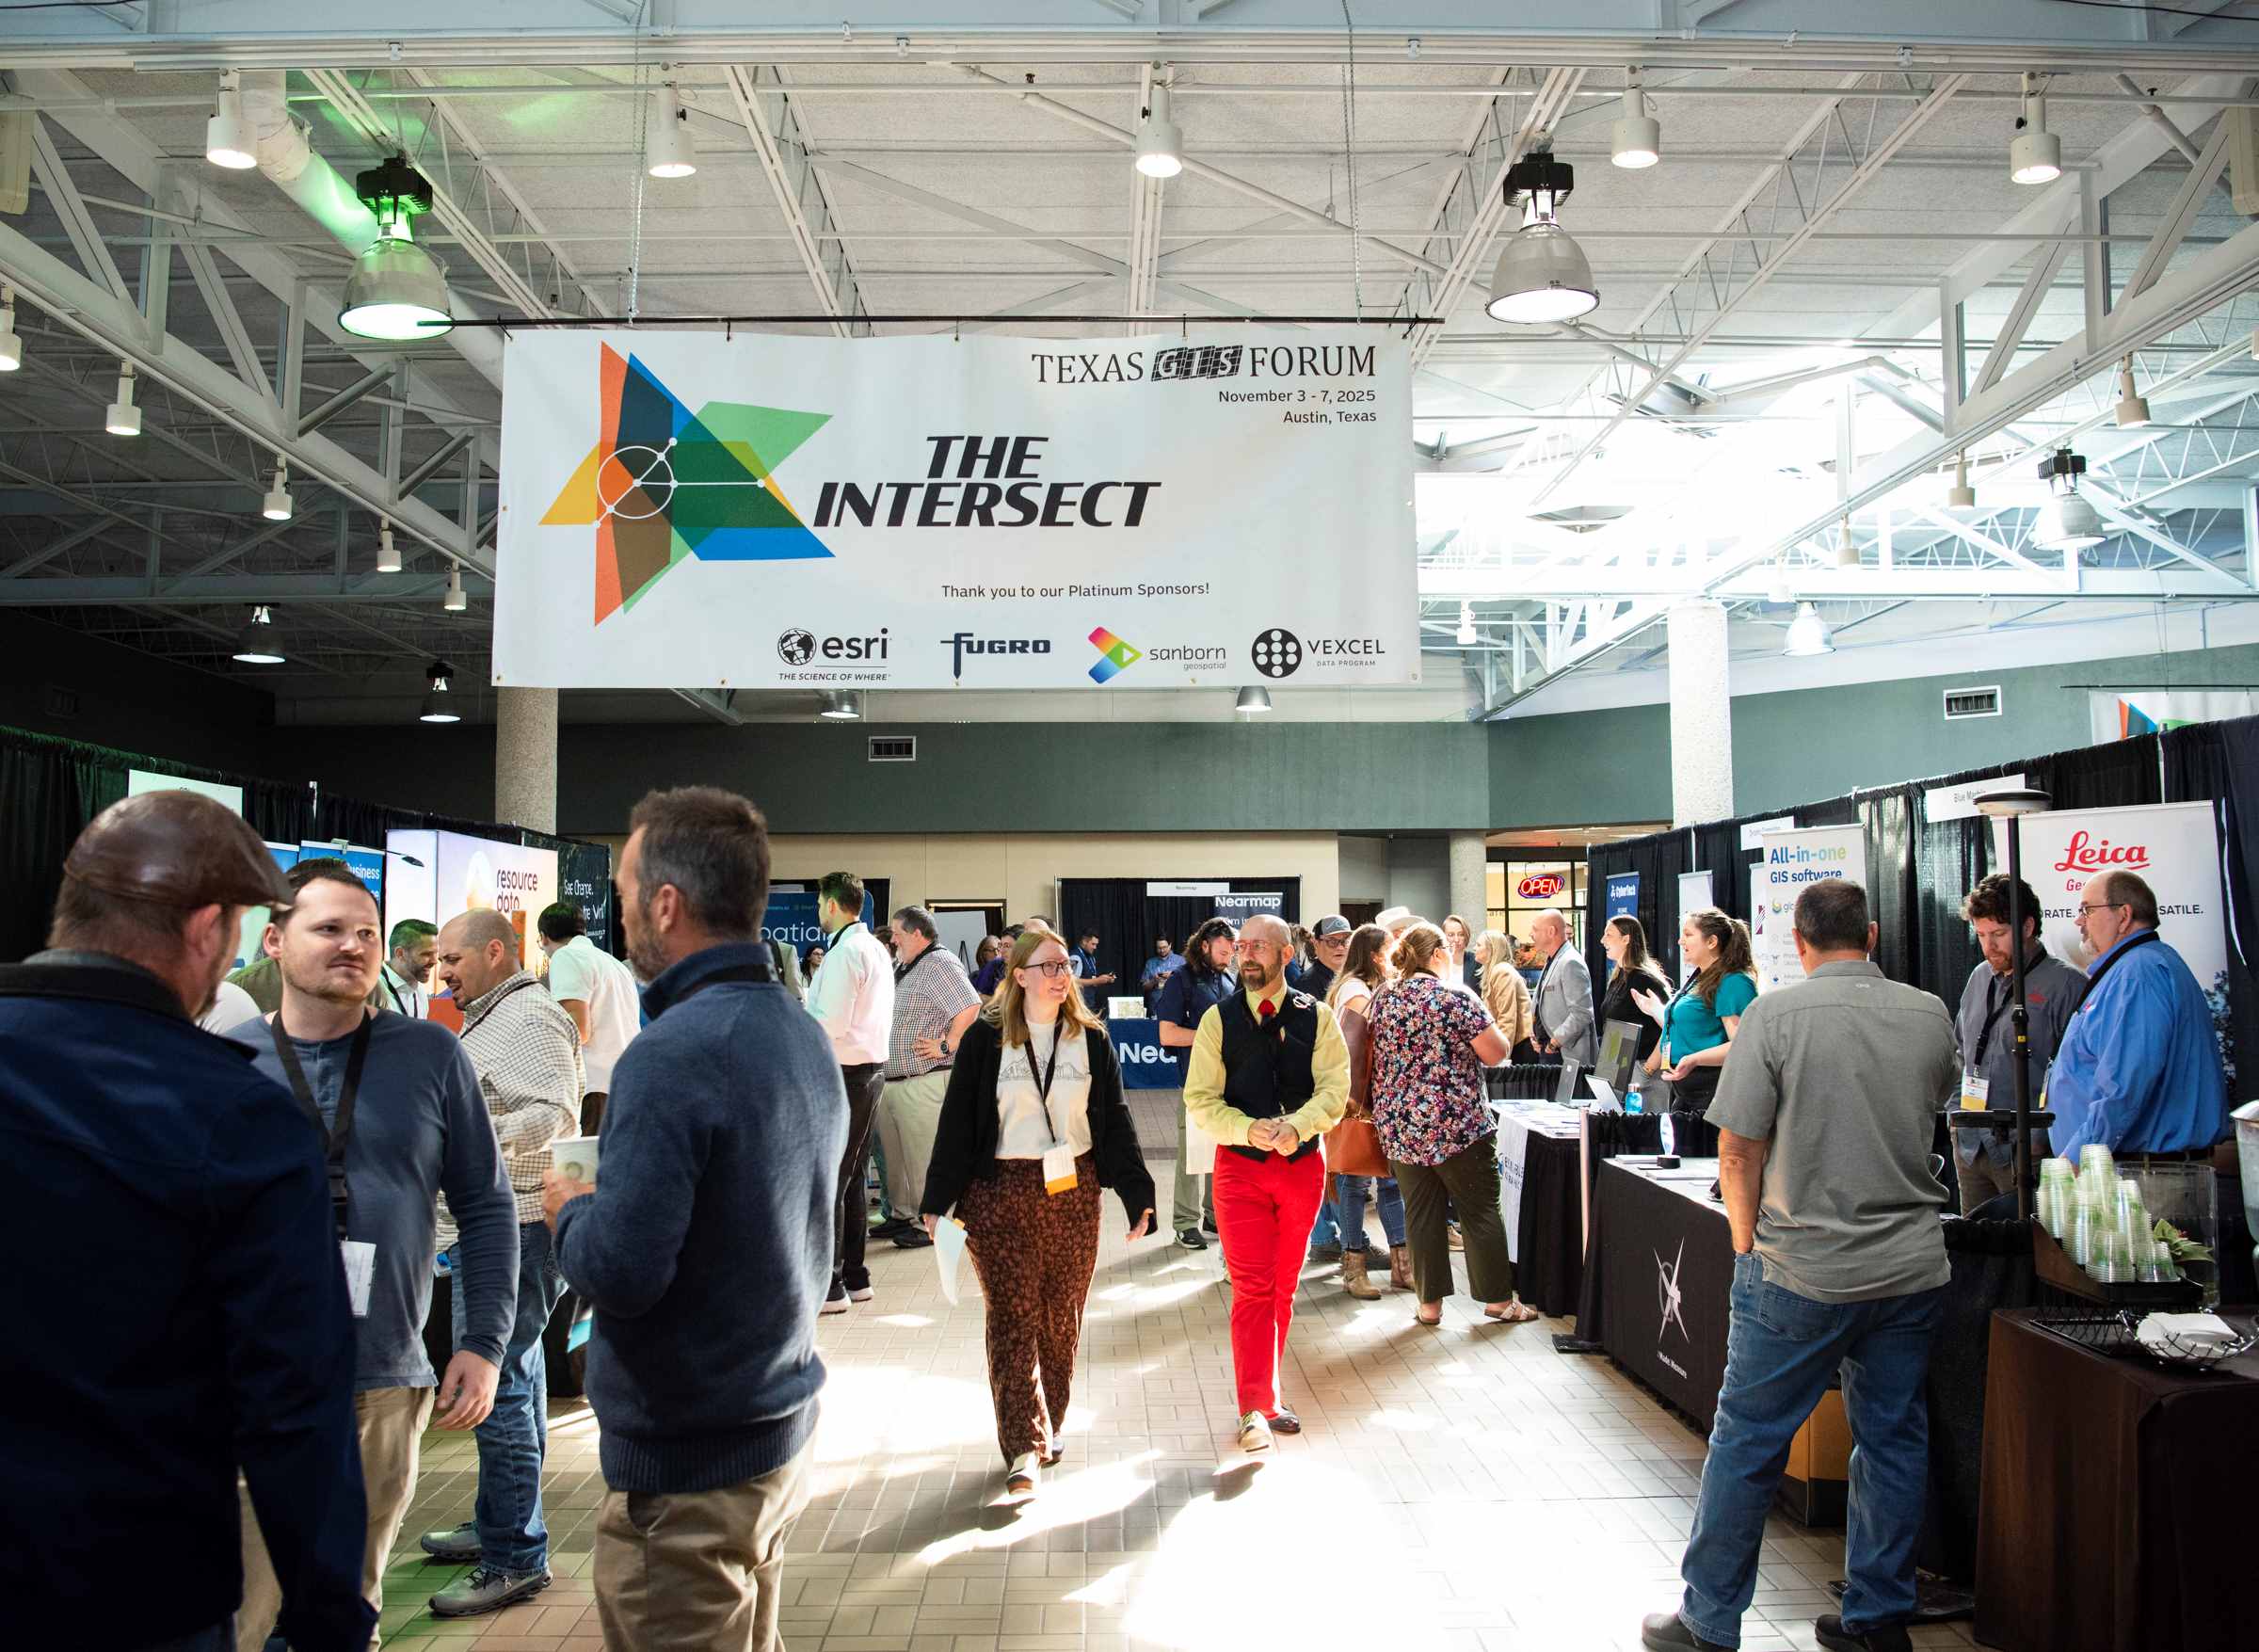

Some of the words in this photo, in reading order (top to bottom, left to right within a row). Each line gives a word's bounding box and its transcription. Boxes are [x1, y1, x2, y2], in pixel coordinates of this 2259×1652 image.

[1032, 352, 1144, 384] TEXAS
[1152, 345, 1242, 381] GIS
[1250, 345, 1376, 377] FORUM
[1219, 391, 1292, 403] November
[1297, 391, 1306, 403] 3
[1322, 391, 1333, 405] 7,
[1338, 390, 1375, 403] 2025
[1283, 410, 1332, 425] Austin,
[1337, 409, 1377, 423] Texas
[926, 436, 1049, 478] THE
[813, 481, 1162, 527] INTERSECT
[942, 585, 985, 598] Thank
[991, 587, 1016, 600] you
[1020, 585, 1034, 598] to
[1040, 586, 1064, 597] our
[1069, 585, 1132, 597] Platinum
[1138, 583, 1210, 597] Sponsors!
[822, 628, 888, 659] esri
[1307, 639, 1386, 654] VEXCEL
[1149, 645, 1226, 661] sanborn
[1183, 662, 1226, 671] geospatial
[1770, 845, 1847, 864] All-in-one
[2055, 830, 2150, 873] Leica
[496, 869, 538, 891] resource
[1770, 871, 1789, 883] GIS
[1791, 868, 1842, 883] software
[565, 879, 573, 895] See
[1521, 878, 1561, 895] OPEN
[1215, 896, 1281, 909] Nearmap
[2159, 905, 2203, 917] SATILE.
[761, 922, 825, 942] atia
